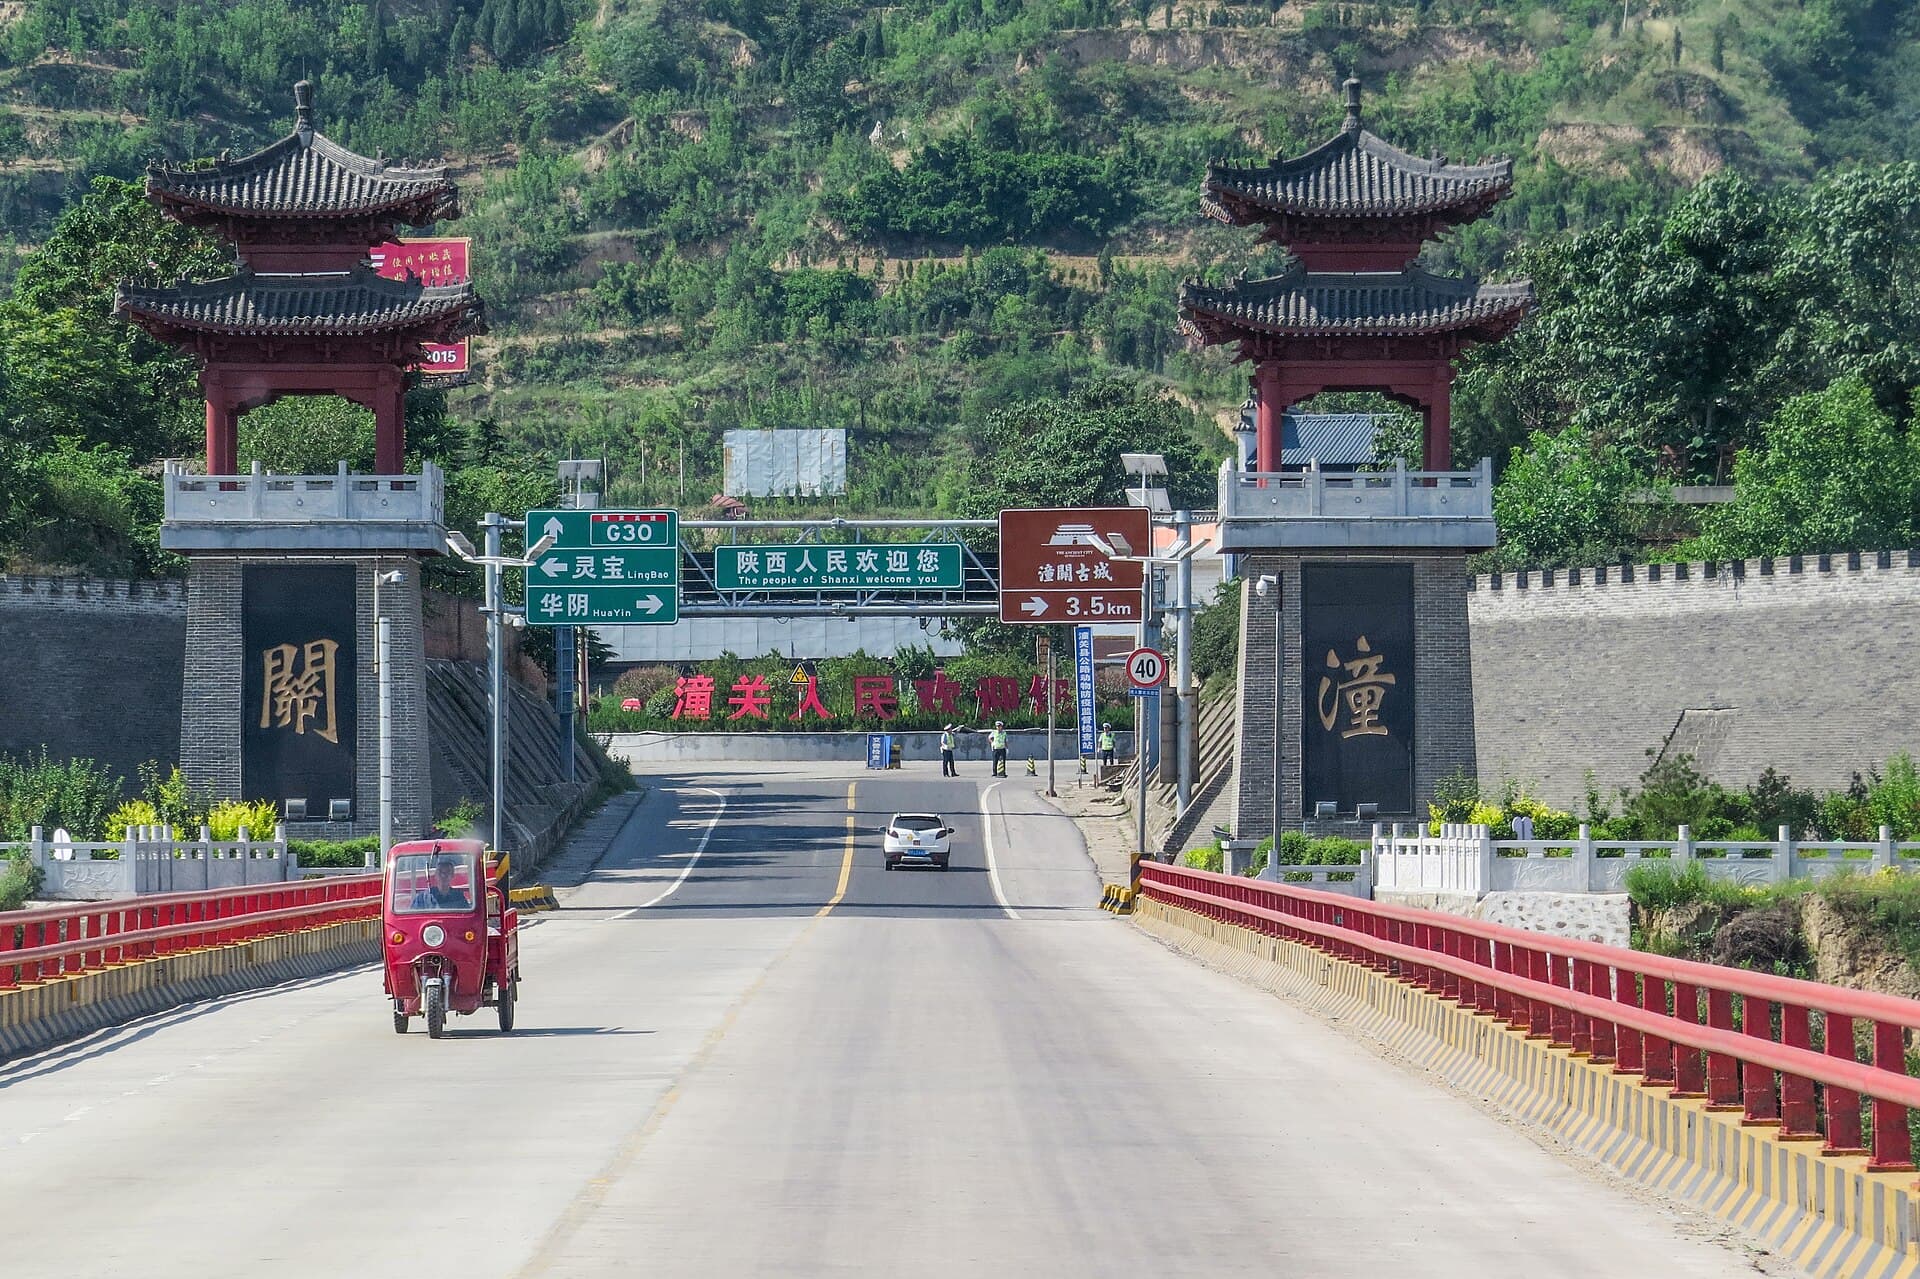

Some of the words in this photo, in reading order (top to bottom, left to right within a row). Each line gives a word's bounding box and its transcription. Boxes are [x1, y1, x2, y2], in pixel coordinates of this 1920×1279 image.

[394, 264, 453, 281] 收中增值
[606, 524, 652, 542] G30
[572, 555, 625, 580] 灵宝
[627, 570, 669, 581] LingBao
[737, 549, 939, 574] 陕西人民欢迎您
[738, 576, 758, 585] The
[762, 576, 797, 586] people
[803, 575, 814, 584] of
[821, 575, 859, 584] Shanxi
[866, 575, 912, 584] welcome
[918, 576, 938, 585] you
[540, 593, 589, 617] 华阴
[593, 609, 631, 617] HuaYin
[1135, 659, 1156, 678] 40
[1078, 631, 1093, 750] 潼关县公路动物防疫监督检查站
[1318, 635, 1396, 739] 潼
